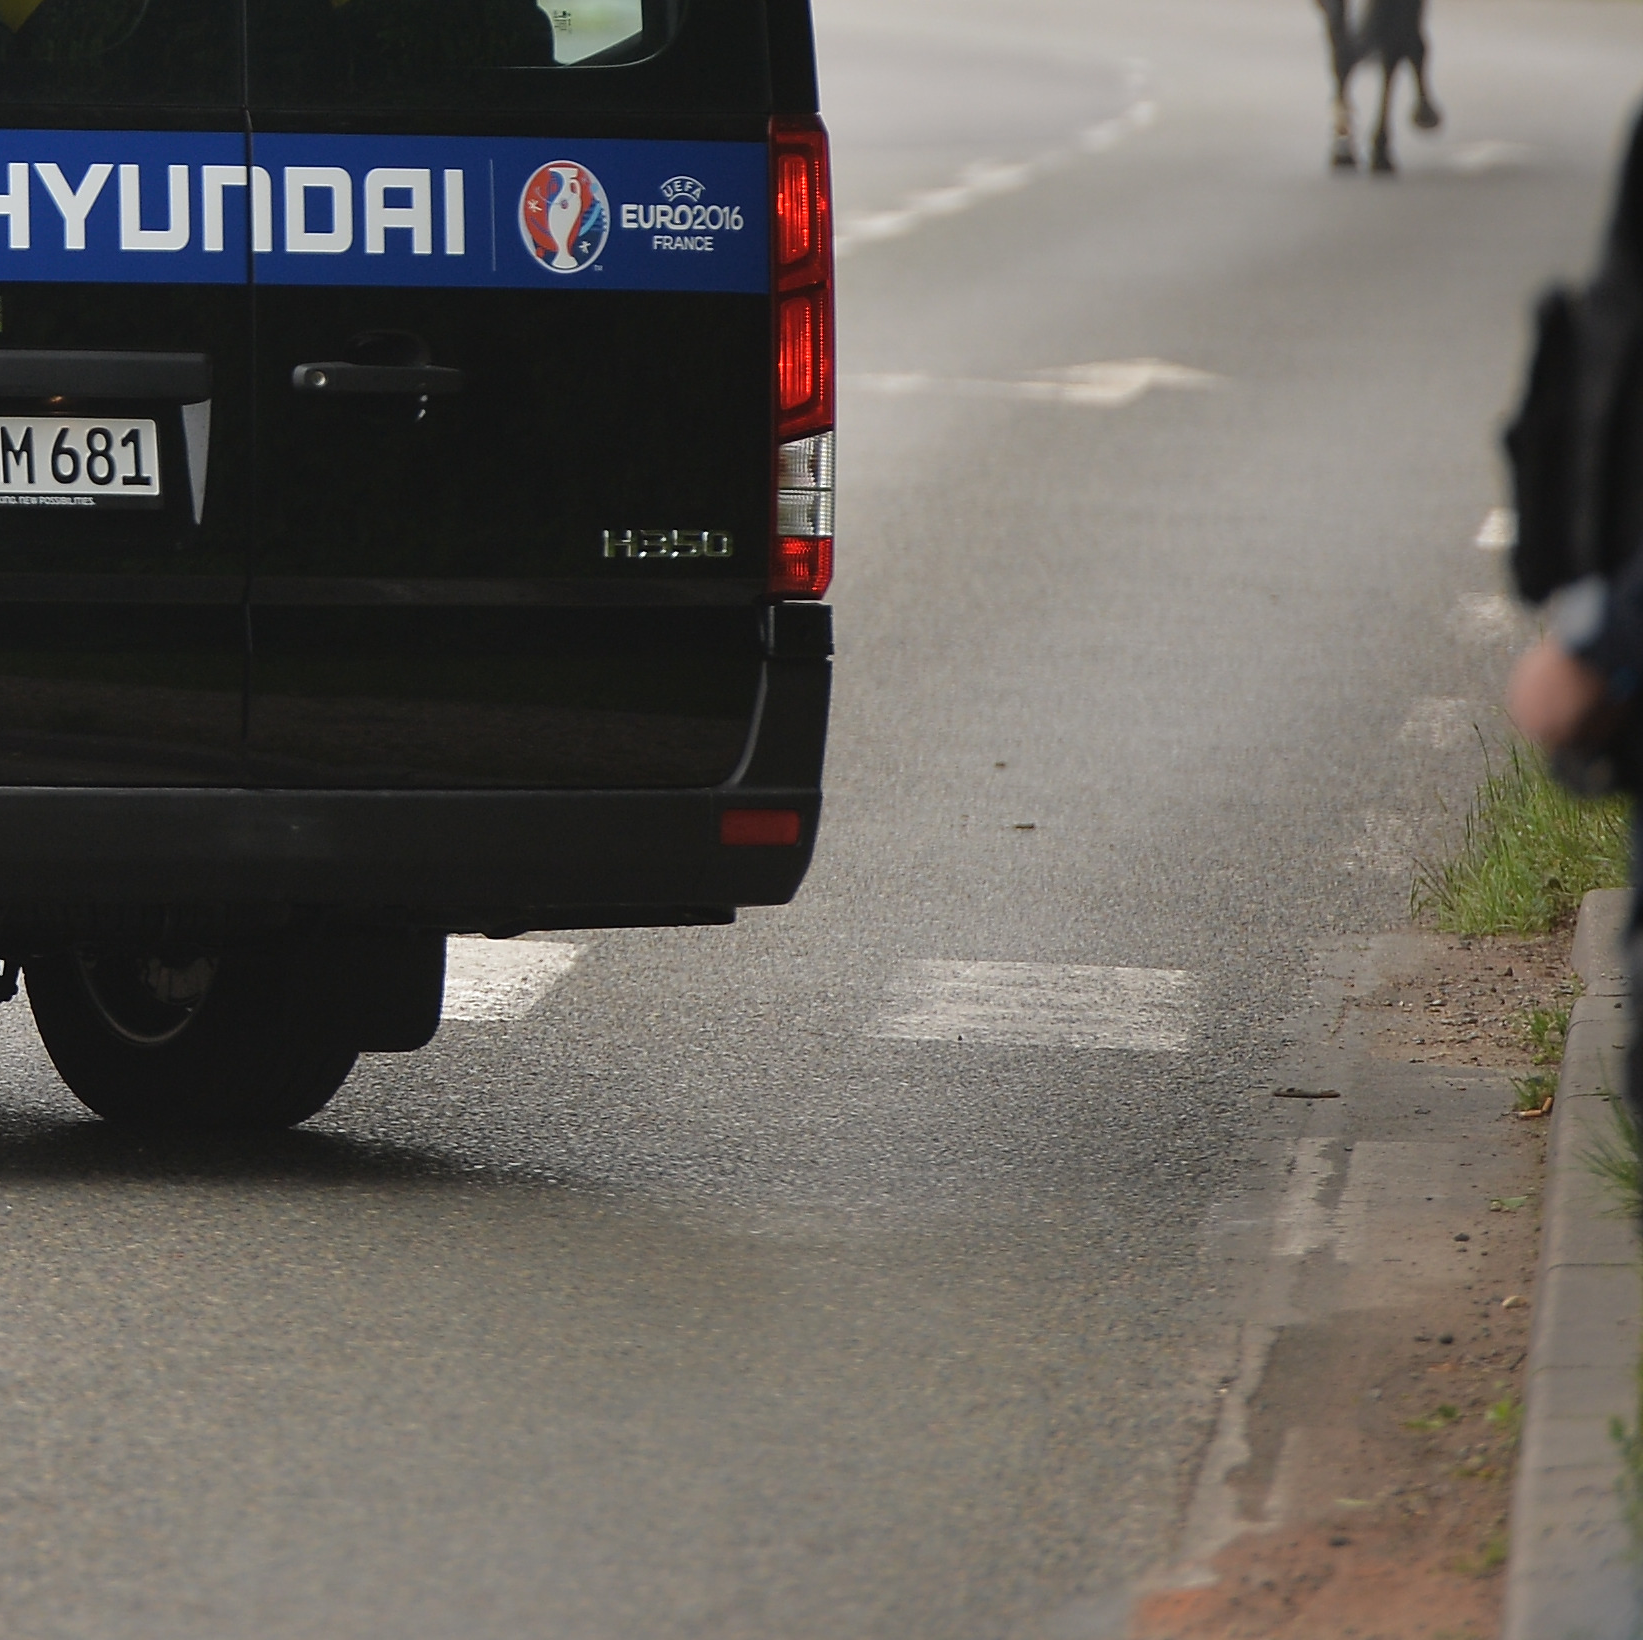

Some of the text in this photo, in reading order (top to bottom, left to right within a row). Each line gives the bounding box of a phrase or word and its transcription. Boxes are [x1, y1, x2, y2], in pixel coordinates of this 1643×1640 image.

[662, 180, 702, 200] UEFA
[621, 203, 744, 231] EURO2016
[653, 235, 714, 251] FRANCE
[50, 426, 152, 486] 681
[603, 529, 733, 558] H350
